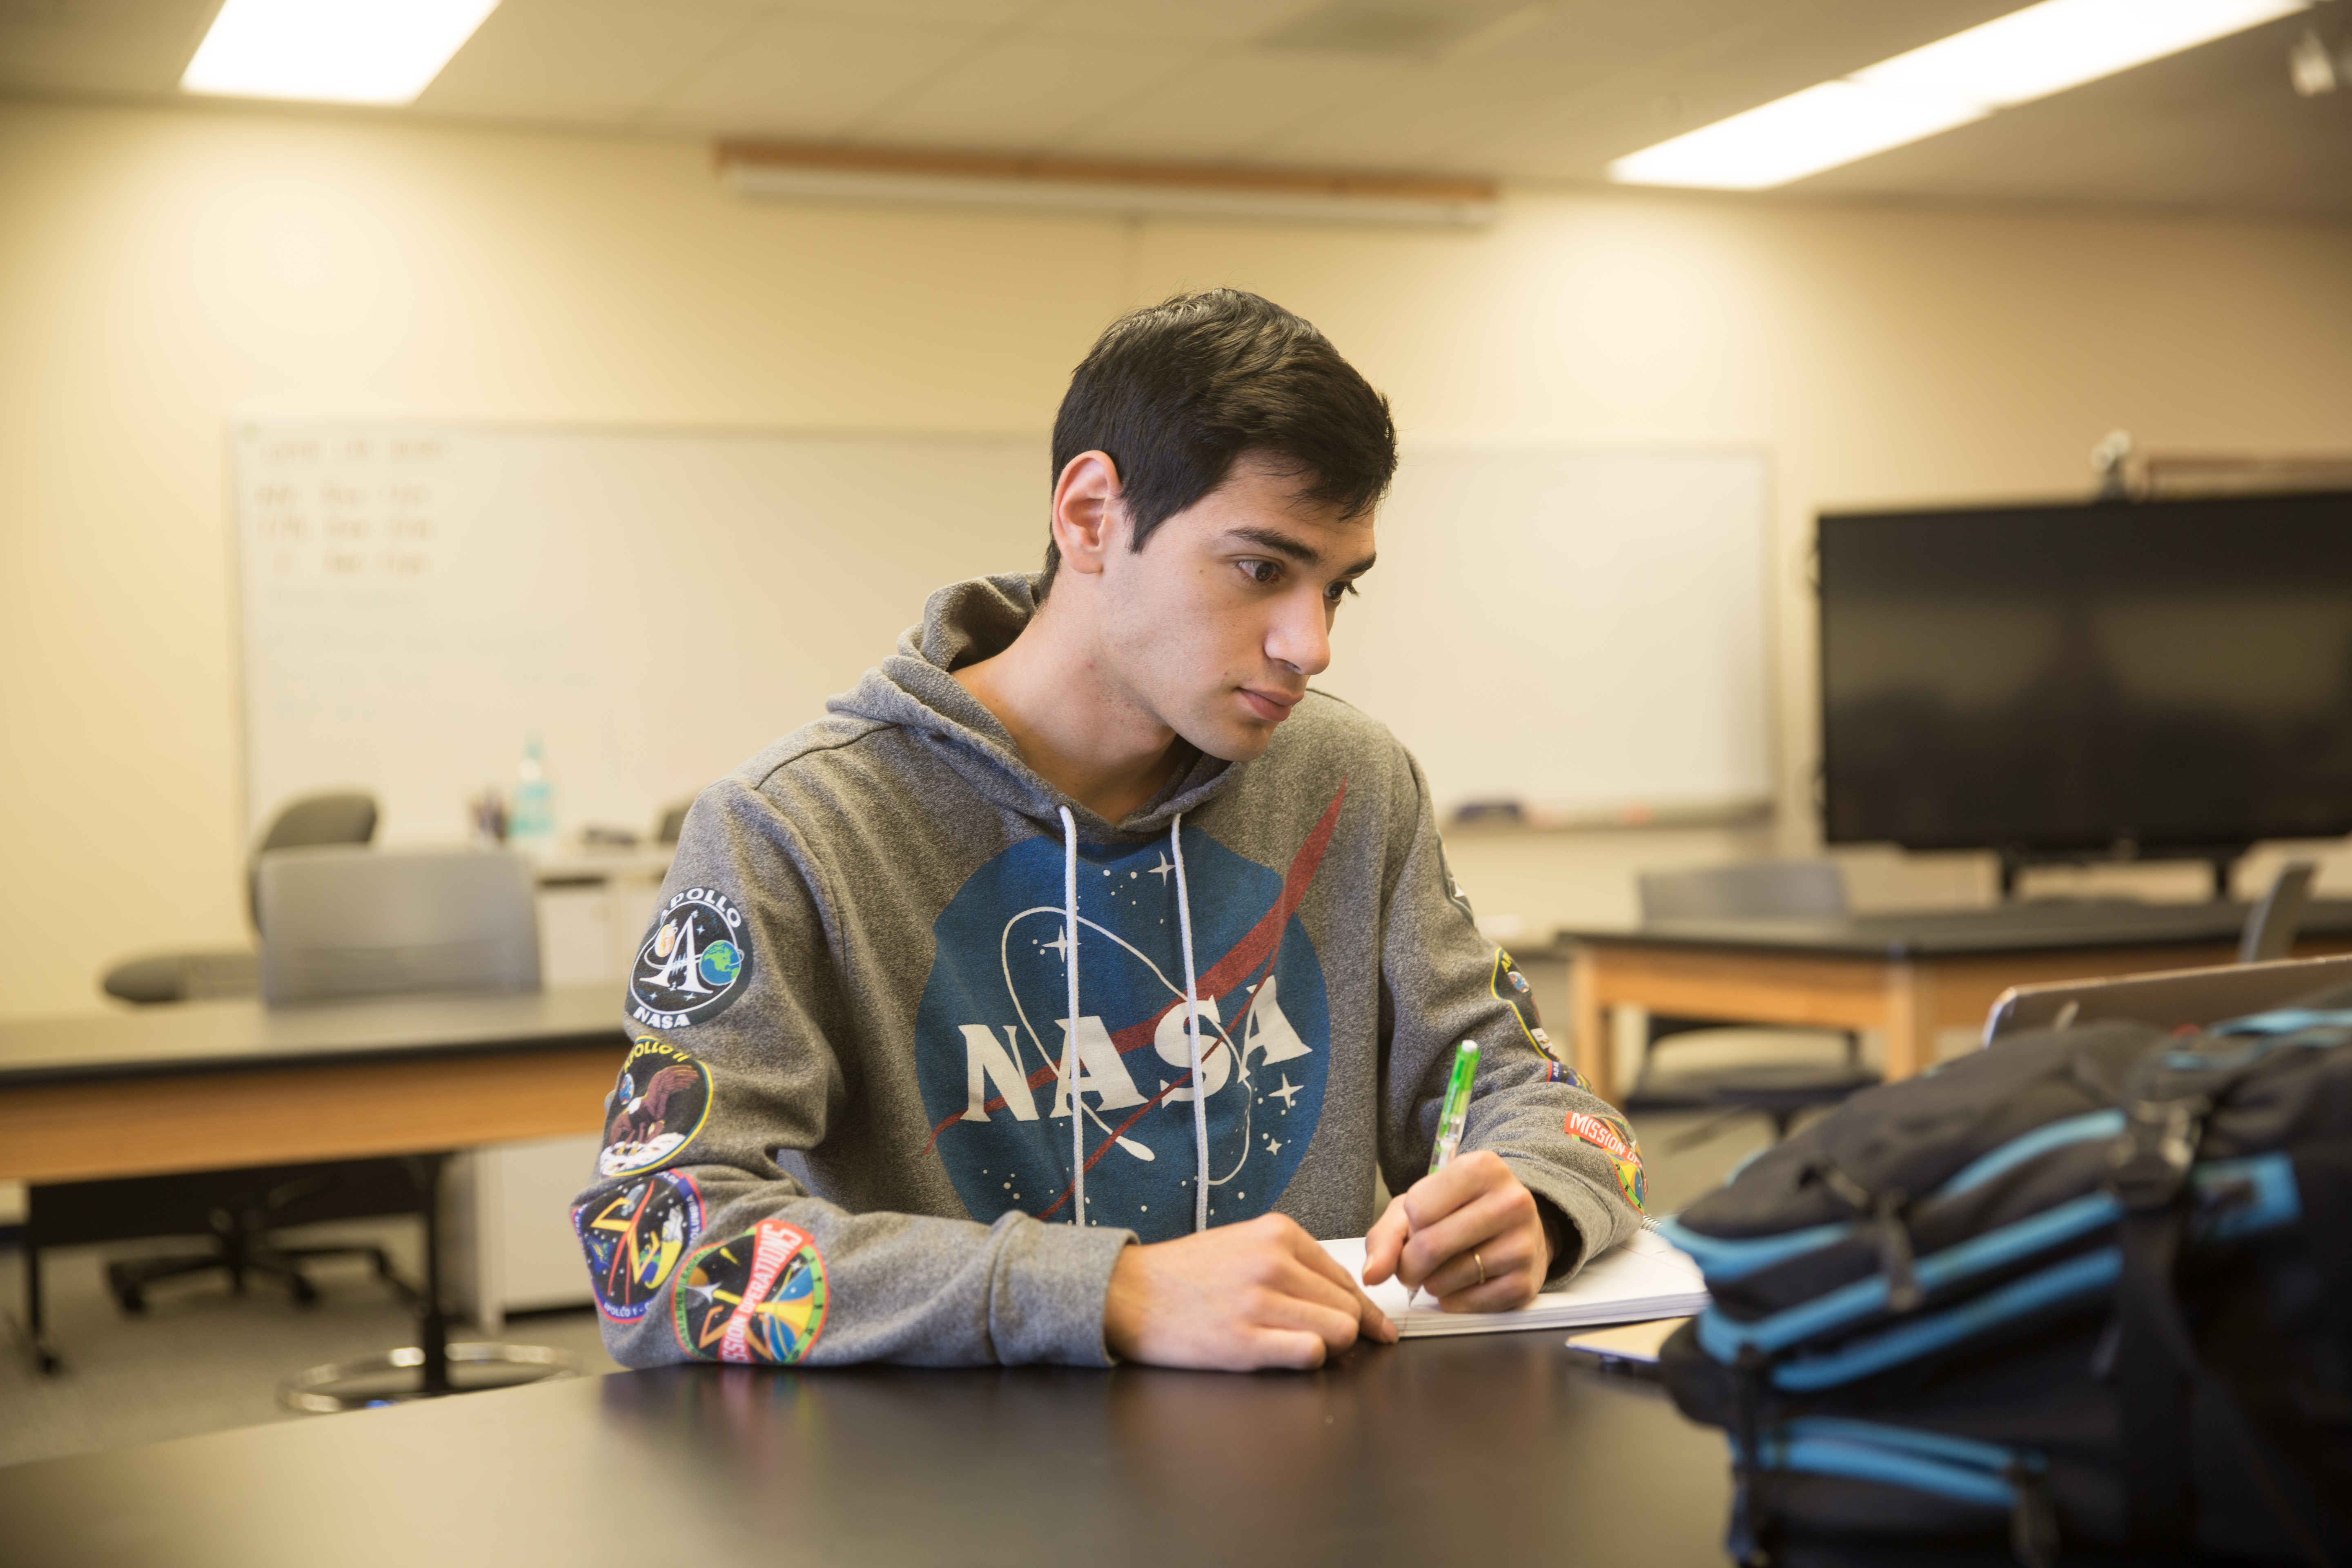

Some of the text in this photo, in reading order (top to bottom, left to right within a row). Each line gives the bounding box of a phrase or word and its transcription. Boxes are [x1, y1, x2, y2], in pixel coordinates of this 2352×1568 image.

[633, 1006, 691, 1029] NASA
[958, 975, 1312, 1122] NASA
[1570, 1112, 1626, 1156] MISSION
[722, 1223, 802, 1363] SSION OPERATIONS
